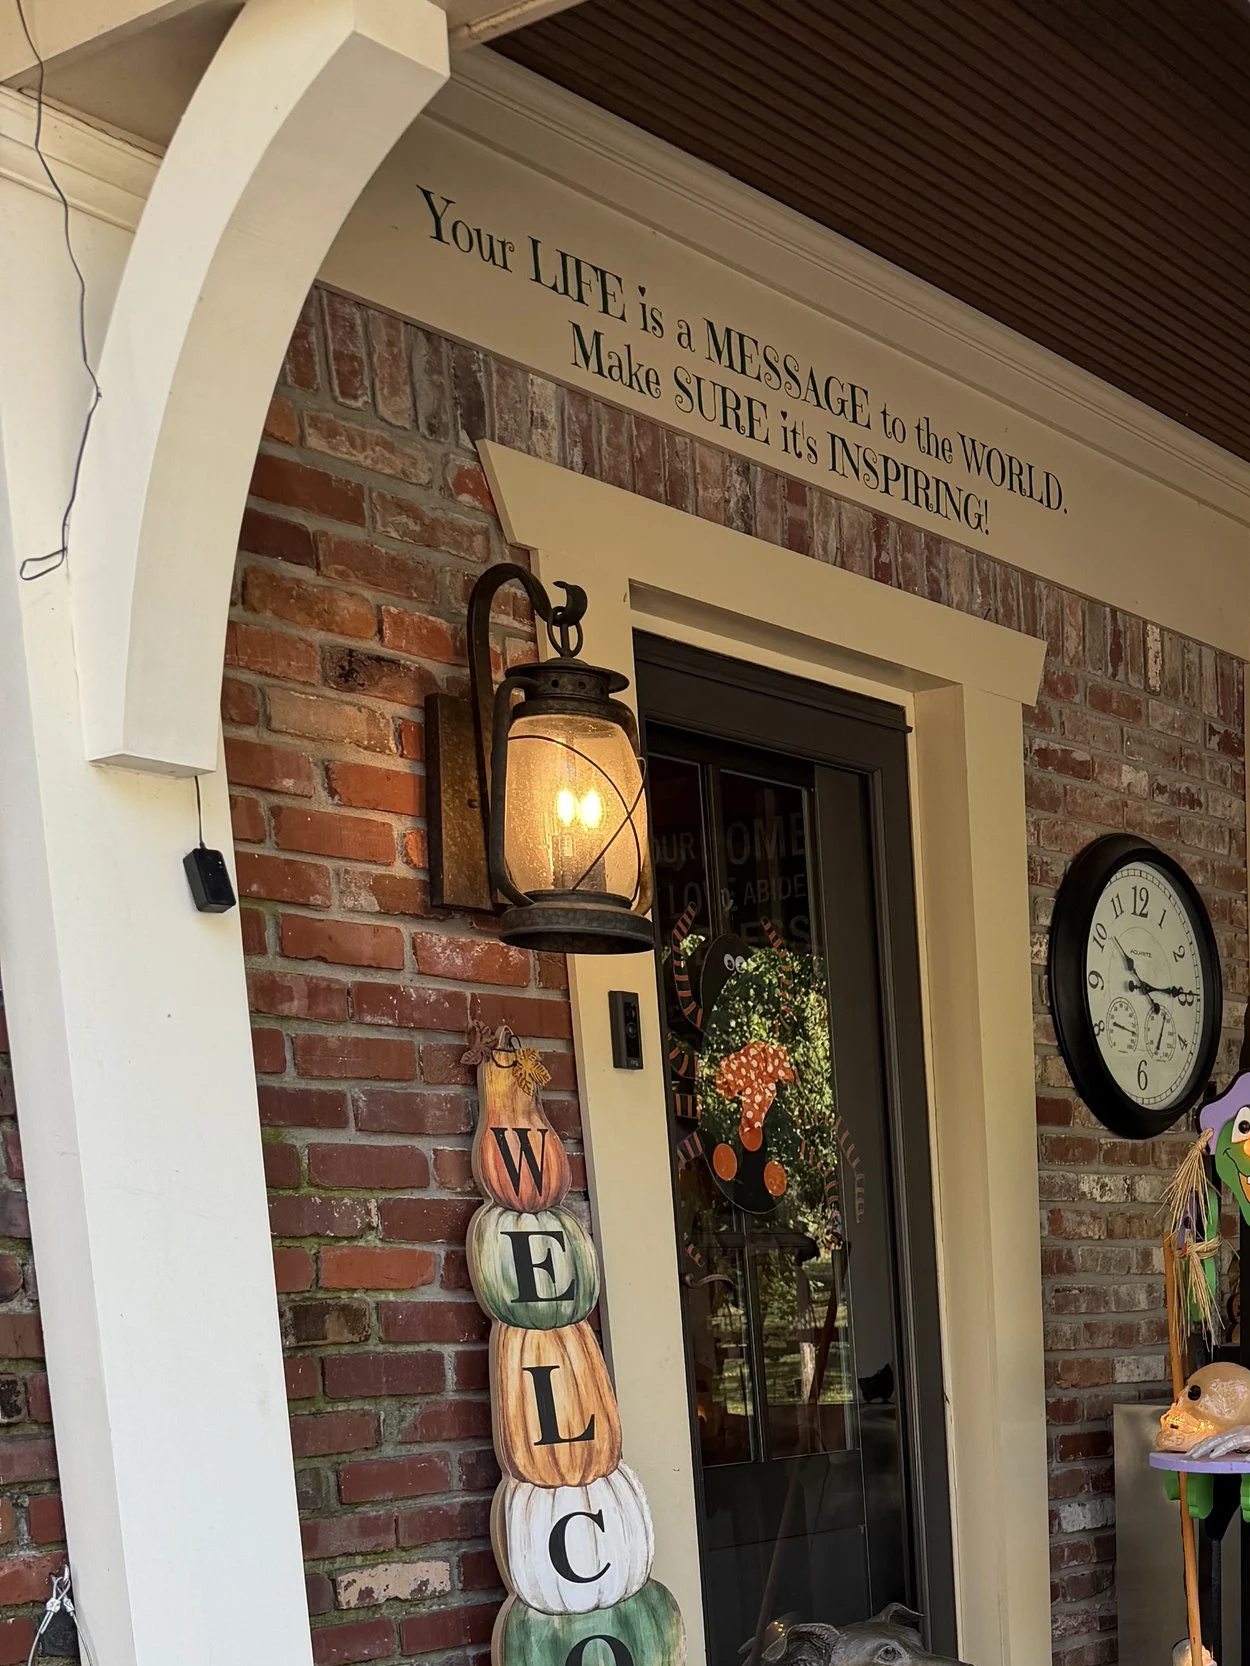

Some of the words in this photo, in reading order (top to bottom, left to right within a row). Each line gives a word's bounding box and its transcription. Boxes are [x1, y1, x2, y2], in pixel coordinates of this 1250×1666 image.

[416, 185, 514, 273] Your
[528, 235, 627, 323] LIFE
[636, 284, 665, 340] is
[676, 317, 692, 351] a
[702, 317, 871, 430] MESSAGE
[880, 401, 908, 445] to
[914, 414, 954, 465] the
[957, 431, 1069, 514] WORLD.
[568, 320, 662, 399] Make
[673, 365, 769, 444] SURE
[780, 408, 818, 465] it's
[827, 431, 991, 536] INSPIRING!
[701, 812, 806, 868] OME
[1111, 893, 1125, 920] 11
[1131, 886, 1149, 918] 12
[1157, 908, 1167, 929] 1
[1092, 922, 1109, 953] 10
[1173, 945, 1185, 963] 2
[1088, 970, 1105, 991] 9
[1177, 1032, 1189, 1051] 4
[1137, 1060, 1148, 1090] 6
